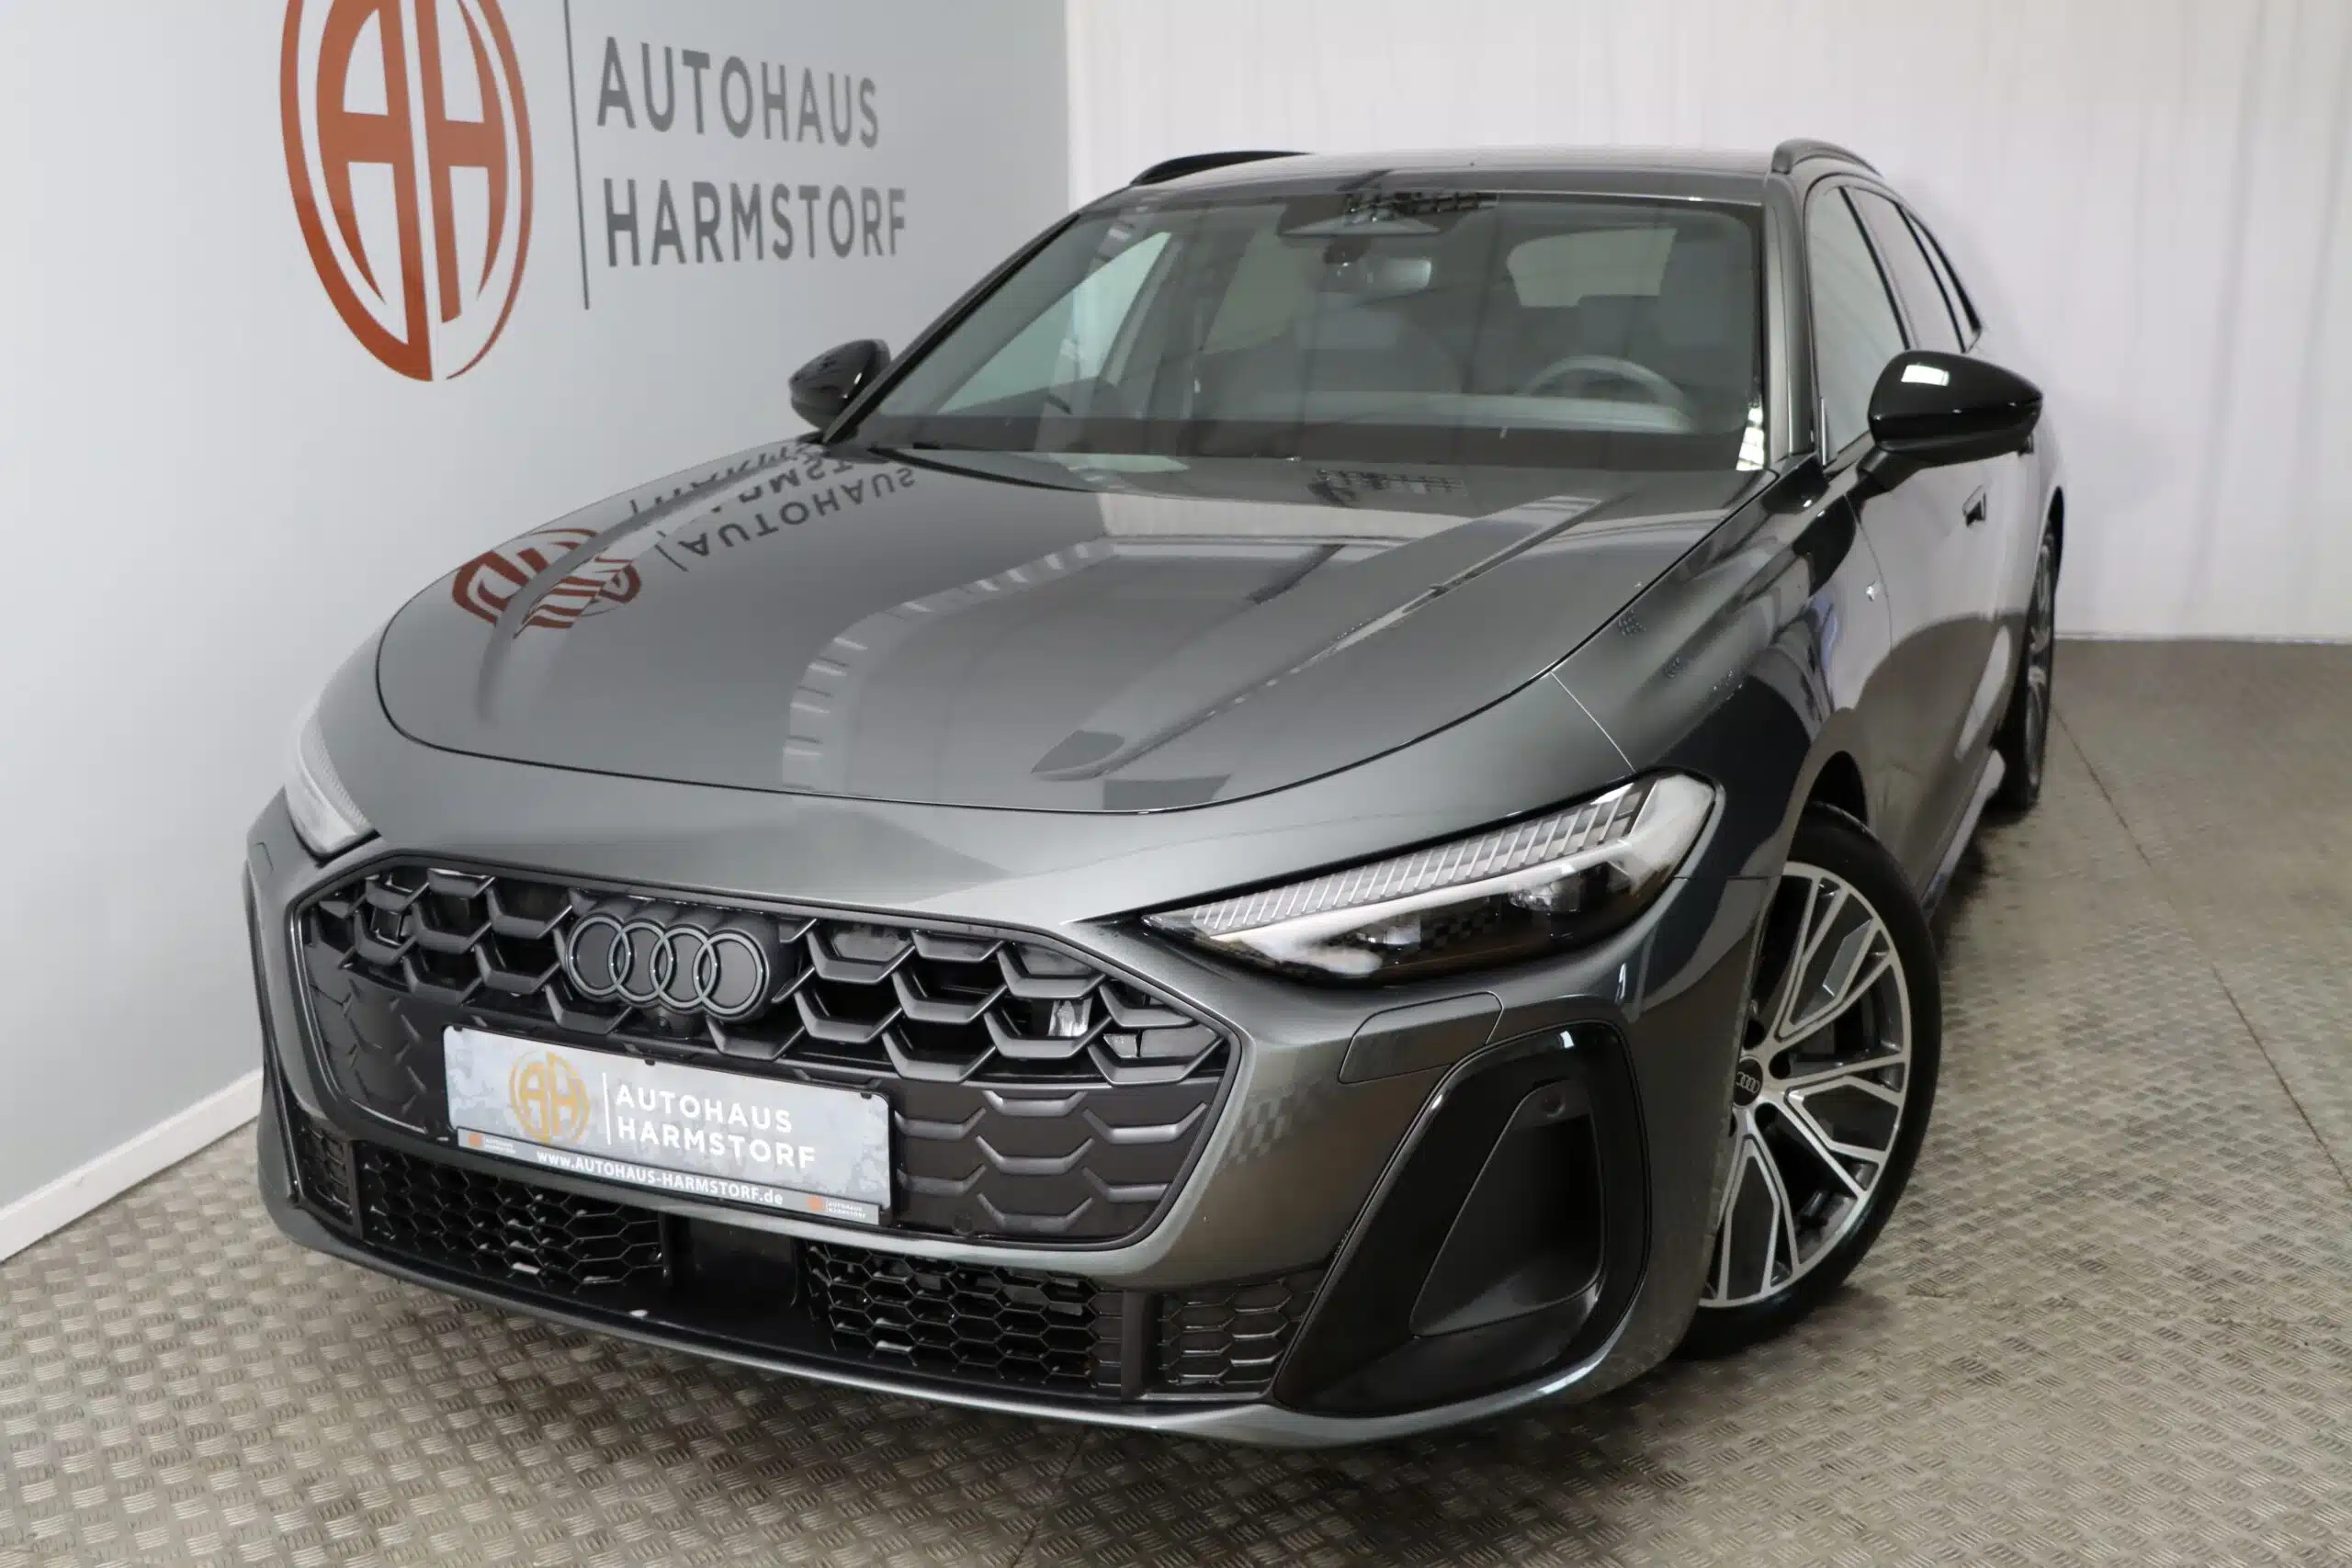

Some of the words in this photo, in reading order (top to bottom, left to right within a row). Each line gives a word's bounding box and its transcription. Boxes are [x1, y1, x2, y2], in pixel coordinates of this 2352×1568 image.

[596, 36, 879, 150] AUTOHAUS
[603, 177, 907, 268] HARMSTORF
[616, 1083, 793, 1134] AUTOHAUS
[617, 1115, 816, 1169] HARMSTORF
[536, 1150, 784, 1206] www.AUTOHAUS-HARMSTORF.de
